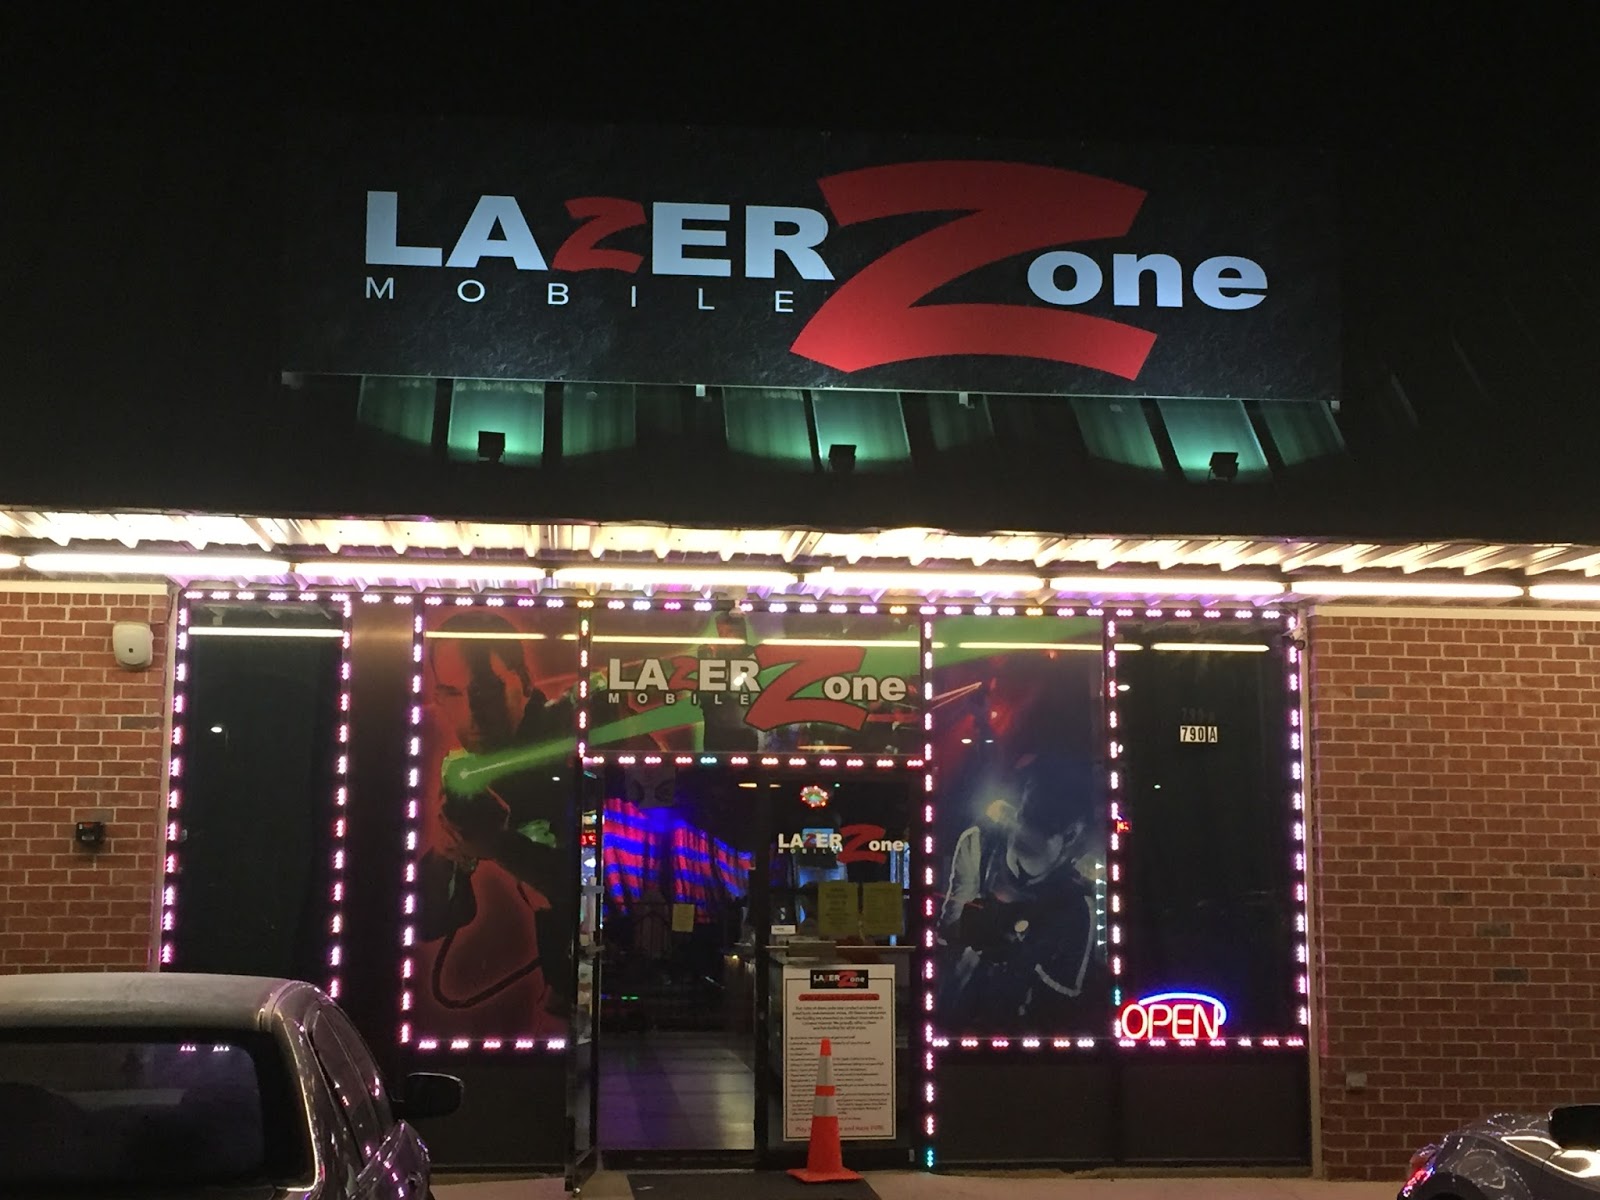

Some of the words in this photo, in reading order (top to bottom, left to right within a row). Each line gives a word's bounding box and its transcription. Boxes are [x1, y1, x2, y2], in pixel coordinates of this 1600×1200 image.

[365, 190, 835, 281] LAZER
[789, 159, 1268, 381] Zone
[365, 277, 794, 313] MOBILE
[608, 656, 761, 693] LAZER
[744, 645, 907, 732] Zone
[608, 692, 749, 705] MOBILE
[778, 833, 843, 850] LAZER
[836, 824, 904, 865] Zone
[837, 970, 865, 988] Zone
[1121, 1003, 1219, 1040] OPEN
